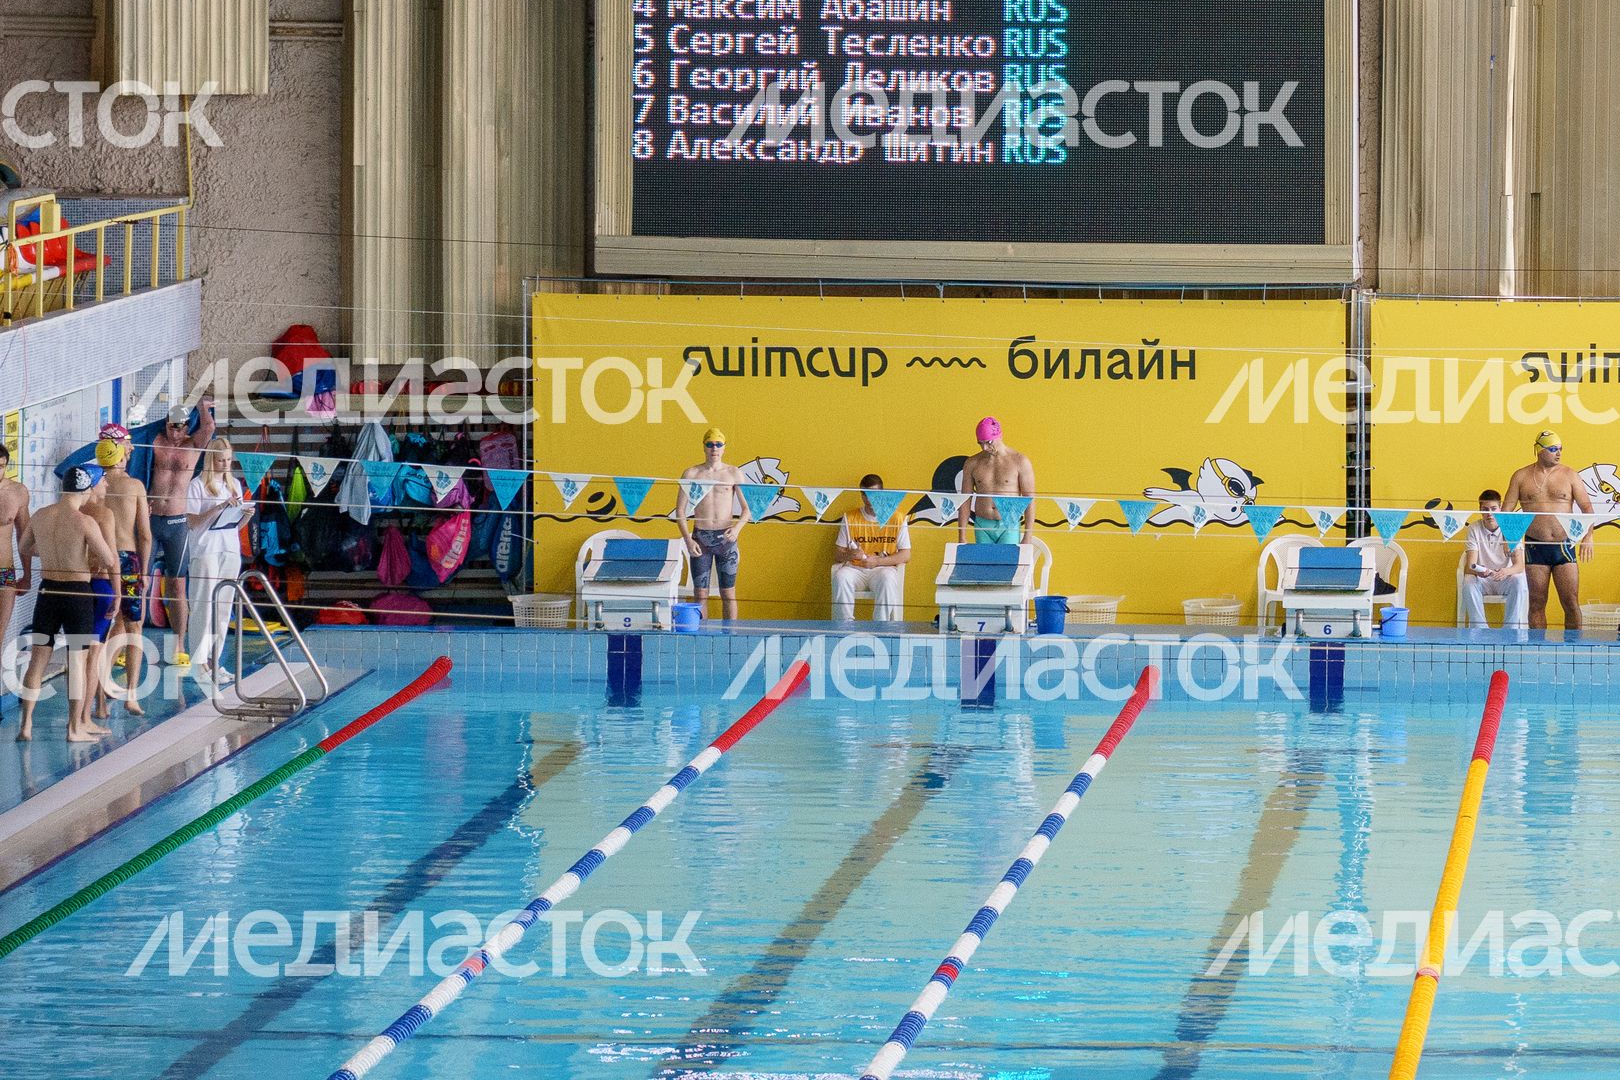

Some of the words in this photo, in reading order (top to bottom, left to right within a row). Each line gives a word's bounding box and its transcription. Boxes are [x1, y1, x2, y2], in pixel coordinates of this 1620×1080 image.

[634, 25, 655, 54] 5
[667, 24, 799, 56] Сергей
[821, 26, 995, 57] Тесленко
[1003, 27, 1068, 57] RUS
[632, 59, 655, 89] 6
[668, 60, 821, 92] Георгий
[1003, 62, 1068, 93] RUS
[632, 95, 655, 123] 7
[668, 96, 821, 126] Василий
[842, 96, 971, 128] Иванов
[1002, 98, 1068, 129] RUS
[632, 130, 654, 159] 8
[667, 131, 863, 163] Александр
[883, 132, 995, 163] Шитин
[1002, 133, 1068, 164] RUS
[682, 337, 888, 387] swimcup
[1008, 336, 1197, 380] билайн
[977, 621, 986, 631] 7
[1323, 624, 1332, 635] 6
